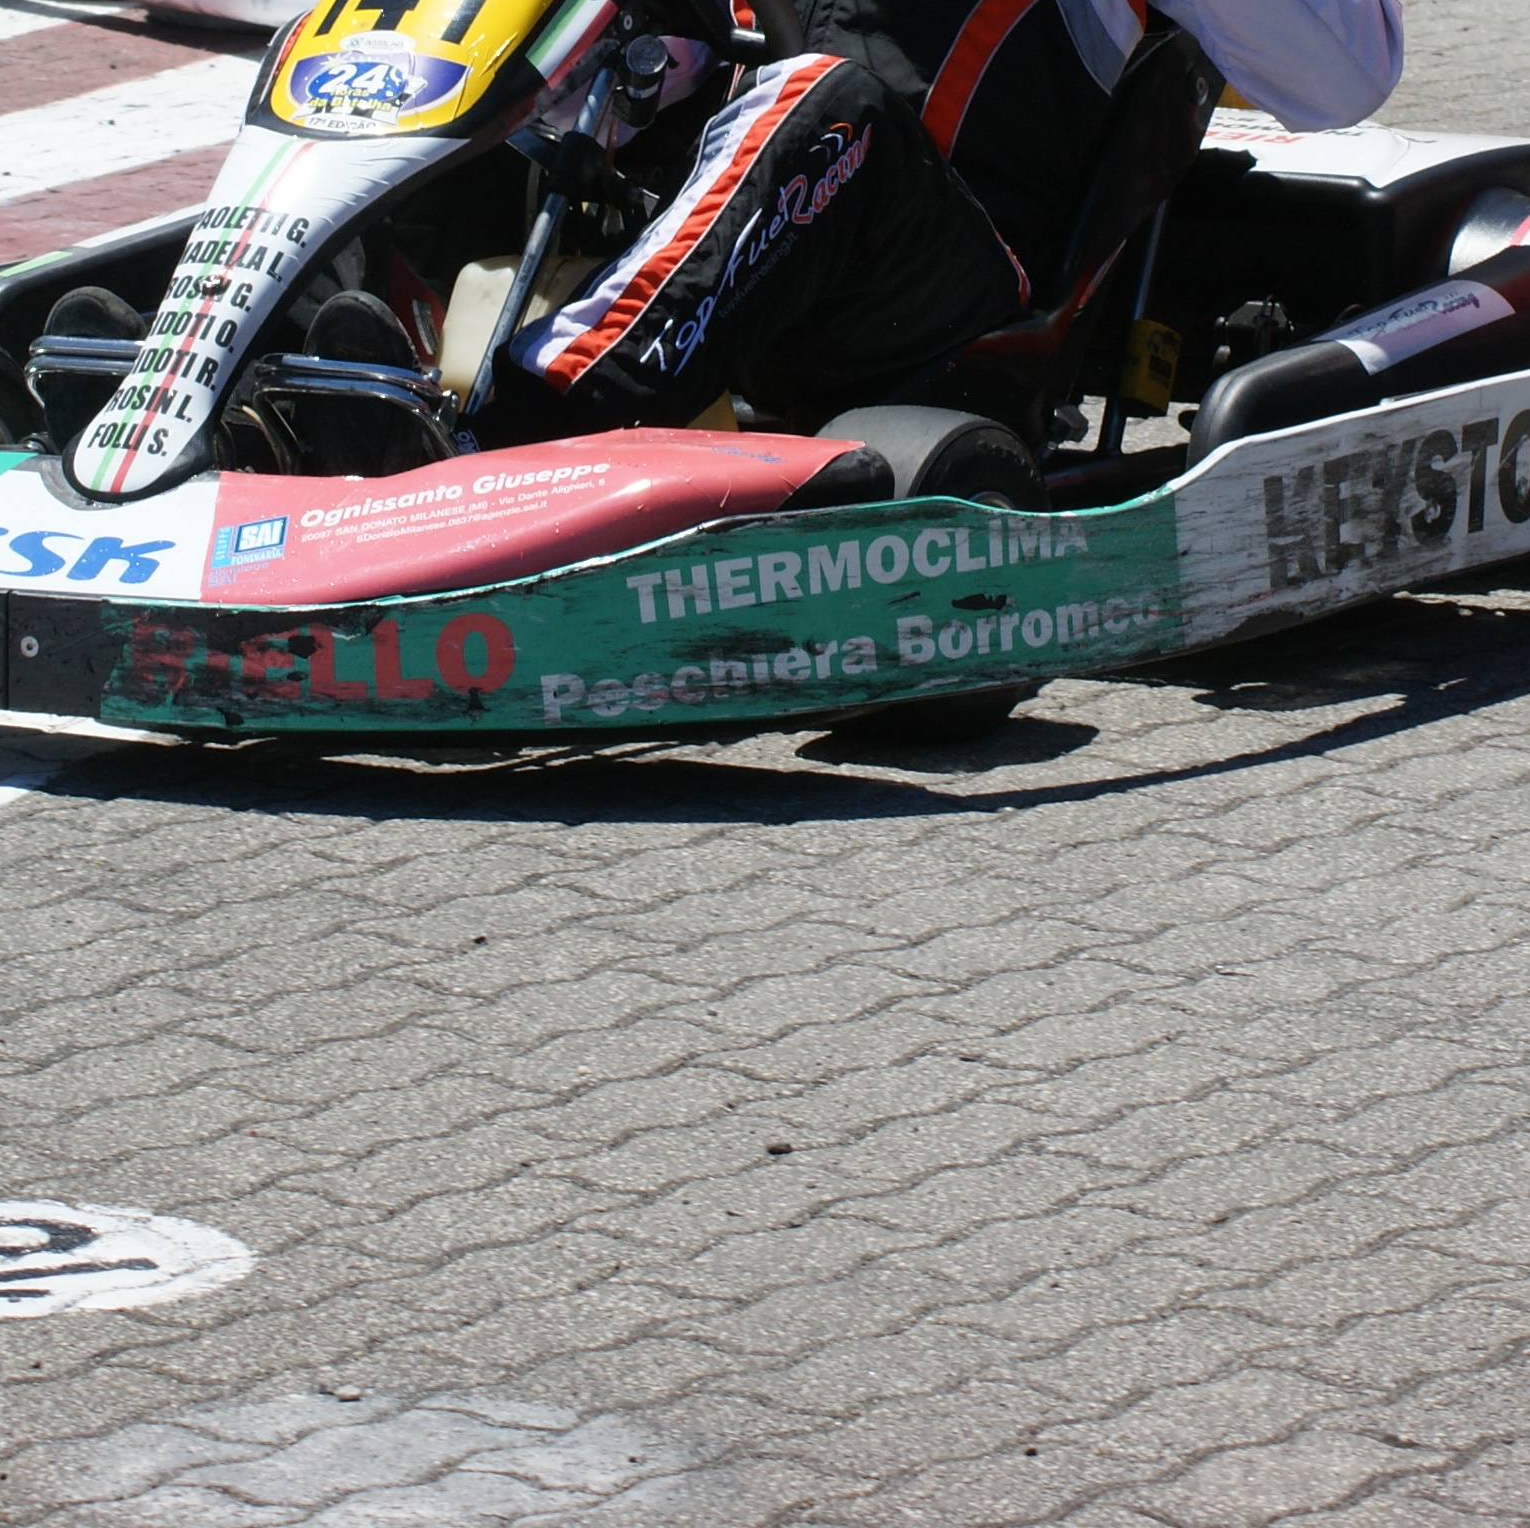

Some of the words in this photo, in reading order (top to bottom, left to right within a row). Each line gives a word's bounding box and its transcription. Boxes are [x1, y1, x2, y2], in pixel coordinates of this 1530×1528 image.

[318, 63, 391, 94] 24
[196, 205, 289, 236] AOLETTI
[286, 216, 310, 249] G.
[179, 239, 269, 272] ADELLA
[266, 251, 285, 284] L.
[230, 281, 254, 313] G.
[149, 310, 218, 341] IDOTI
[215, 319, 239, 354] O.
[132, 347, 199, 379] IDOTI
[195, 355, 221, 392] R.
[173, 394, 193, 424] L.
[86, 421, 149, 452] FOLLI
[147, 427, 171, 457] S.
[299, 482, 464, 528] Ognissanto
[472, 462, 611, 495] Giuseppe
[335, 524, 358, 537] SAN
[361, 515, 407, 531] DONATO
[409, 504, 466, 523] MILANESE
[498, 496, 515, 506] Via
[517, 489, 549, 503] Dante
[239, 519, 285, 552] SAI
[625, 516, 1089, 625] THERMOCLIMA
